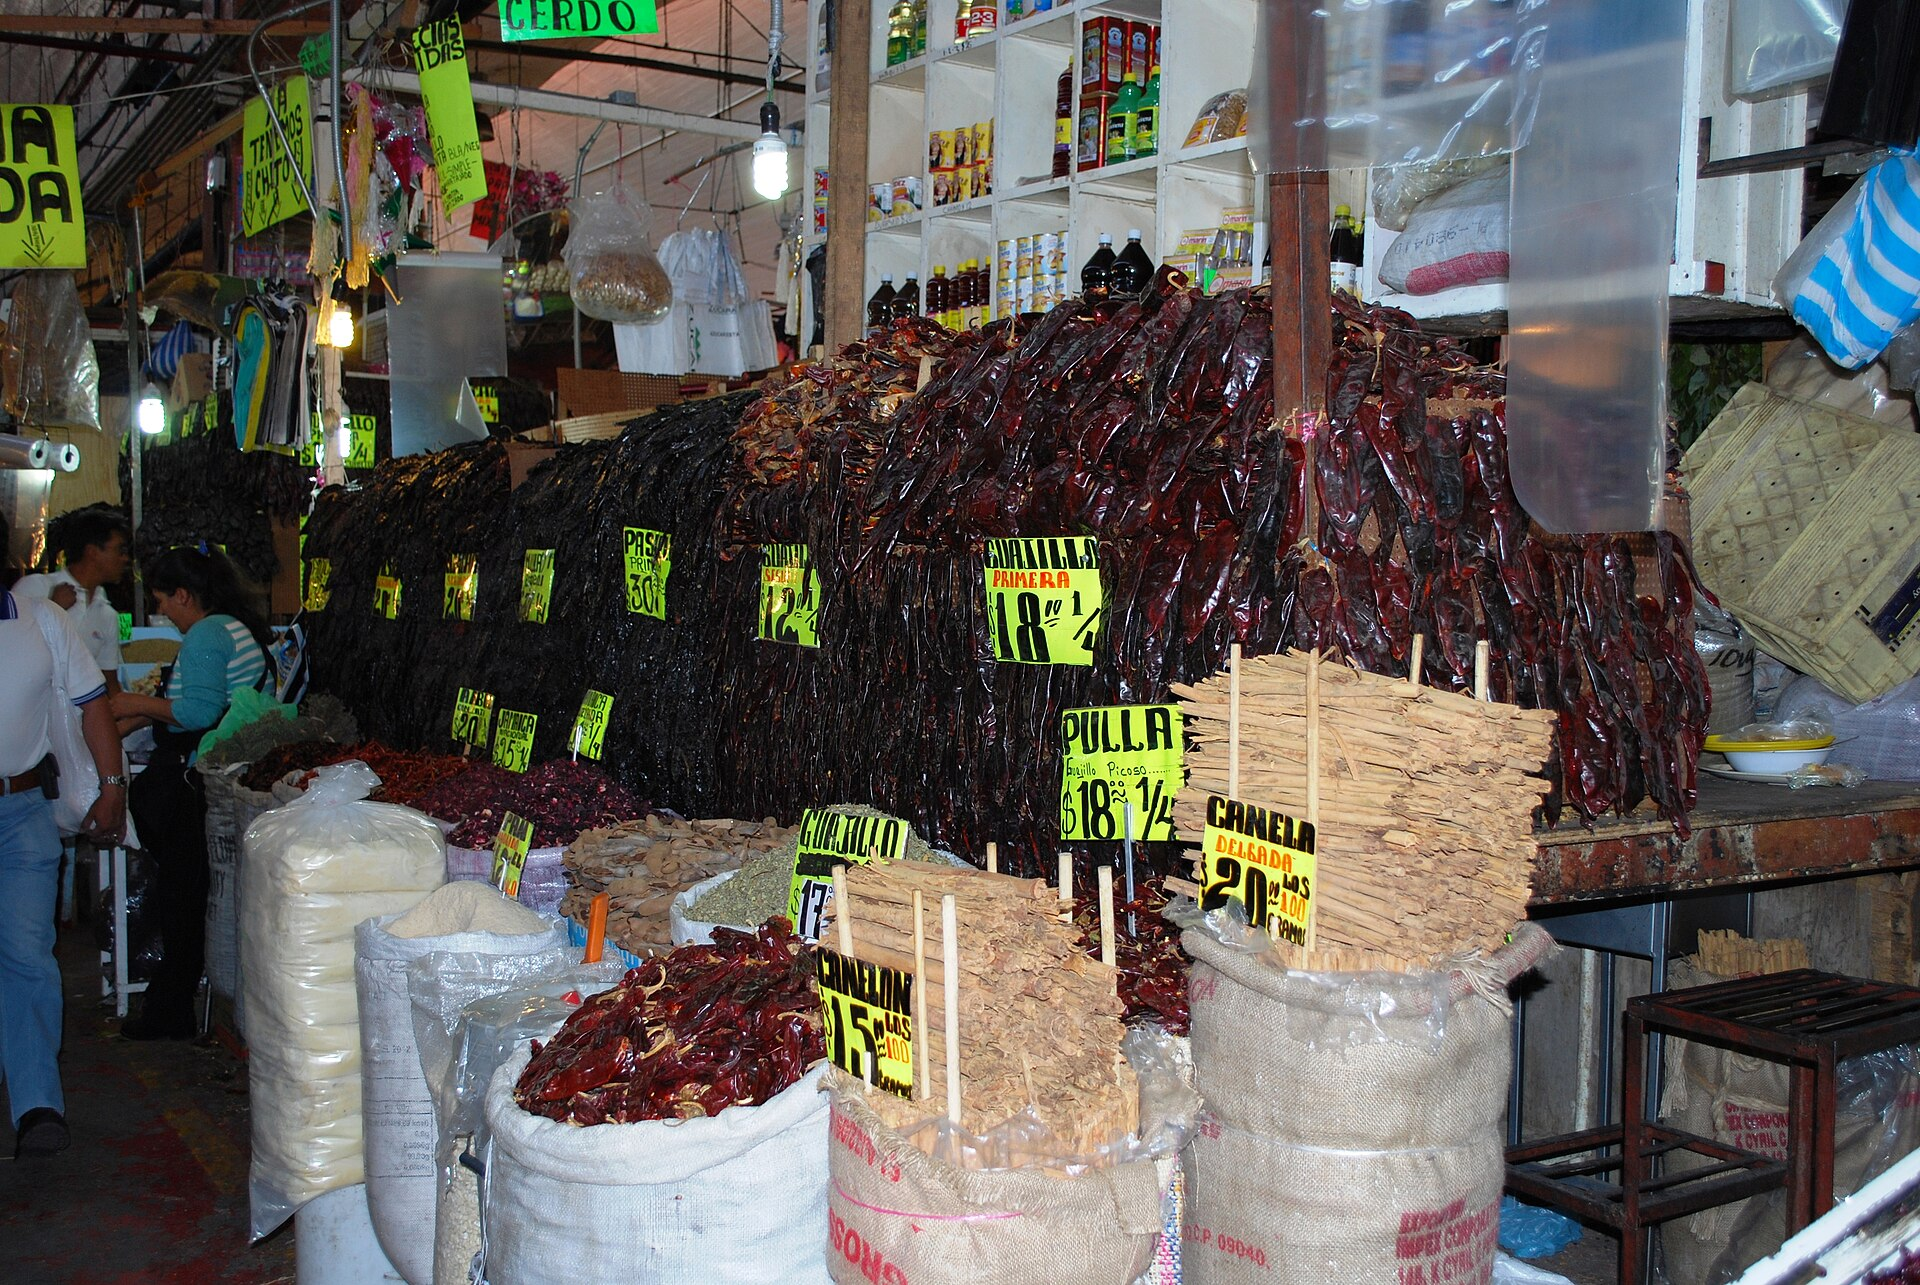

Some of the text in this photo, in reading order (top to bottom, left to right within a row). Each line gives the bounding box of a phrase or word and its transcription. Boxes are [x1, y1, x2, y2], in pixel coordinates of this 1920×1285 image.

[506, 0, 636, 32] CERDO
[0, 105, 60, 167] A
[993, 570, 1070, 589] PRIMERA
[1063, 707, 1174, 756] PULLA
[800, 810, 899, 860] GUAJILLO
[1206, 795, 1316, 855] CANELA
[1215, 834, 1294, 874] DELGADA
[1282, 873, 1310, 900] LOS
[1279, 891, 1307, 923] 100
[816, 946, 913, 1017] CANELON
[885, 1012, 911, 1042] LOS
[885, 1036, 910, 1063] 100
